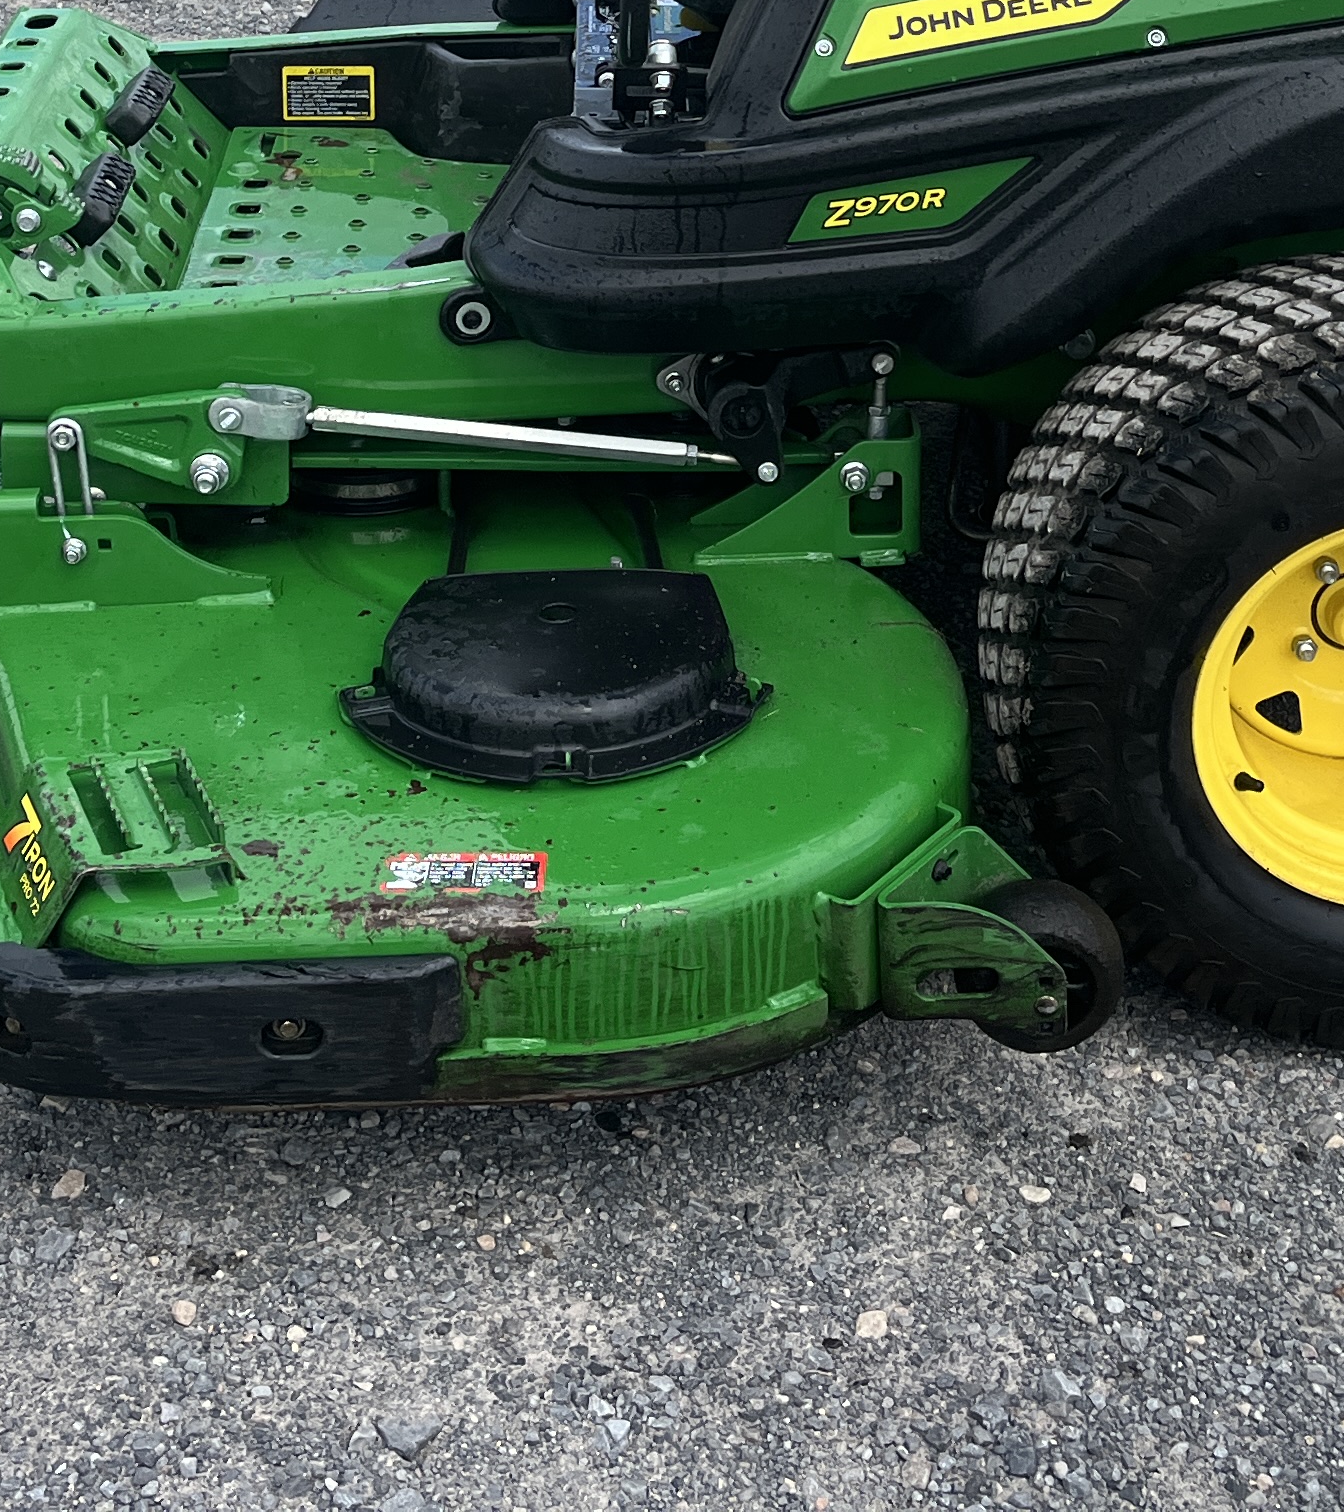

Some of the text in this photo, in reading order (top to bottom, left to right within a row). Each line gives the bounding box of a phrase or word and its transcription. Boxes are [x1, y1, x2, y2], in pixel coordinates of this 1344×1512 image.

[888, 7, 975, 40] JOHN
[19, 872, 40, 917] PRO 72
